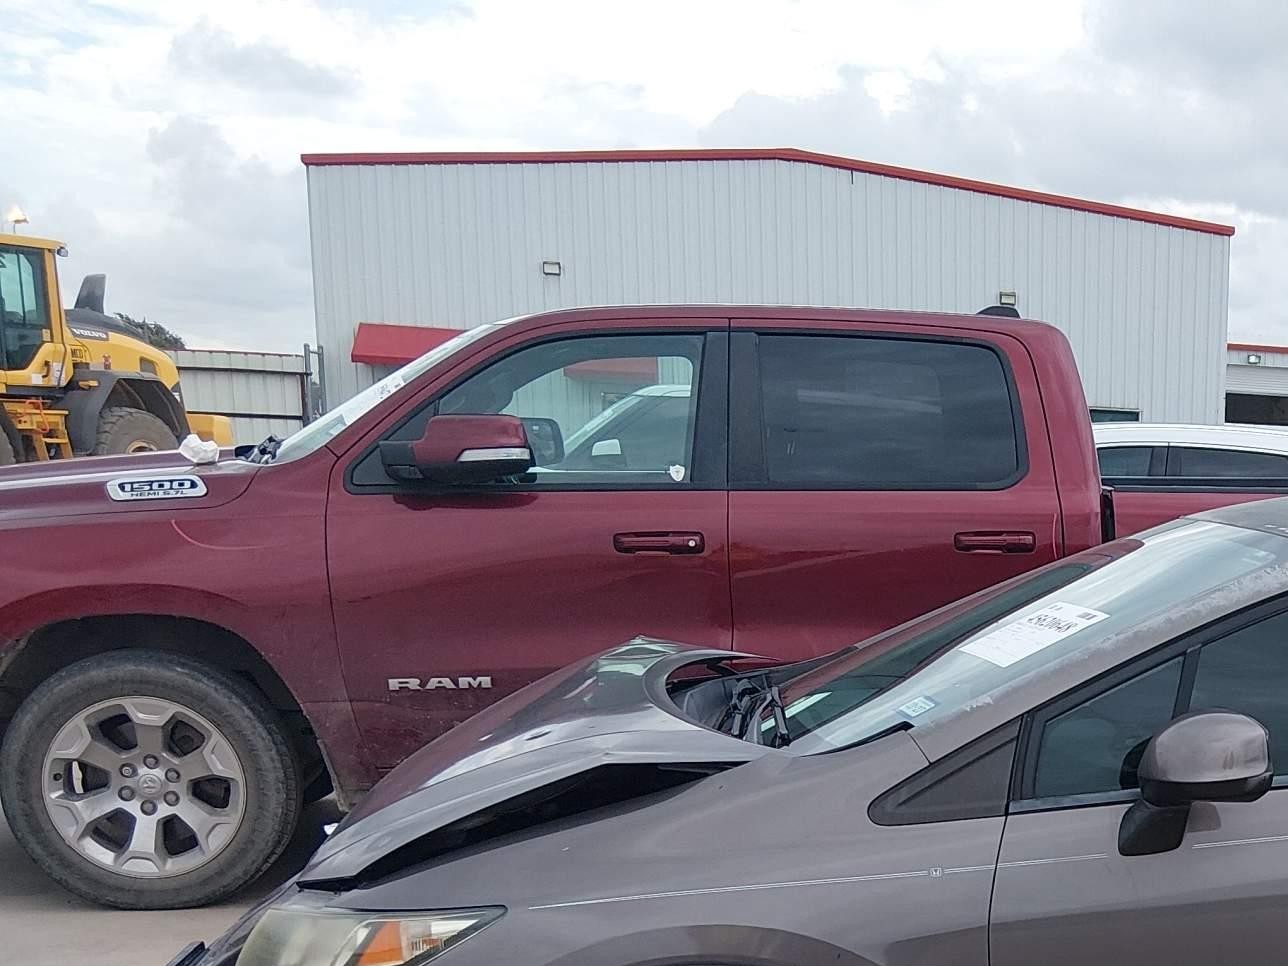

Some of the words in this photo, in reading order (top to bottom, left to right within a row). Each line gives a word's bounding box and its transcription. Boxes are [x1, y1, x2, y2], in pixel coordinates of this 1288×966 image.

[70, 327, 107, 338] VOLVO
[123, 480, 191, 491] 1500
[387, 676, 492, 691] RAM
